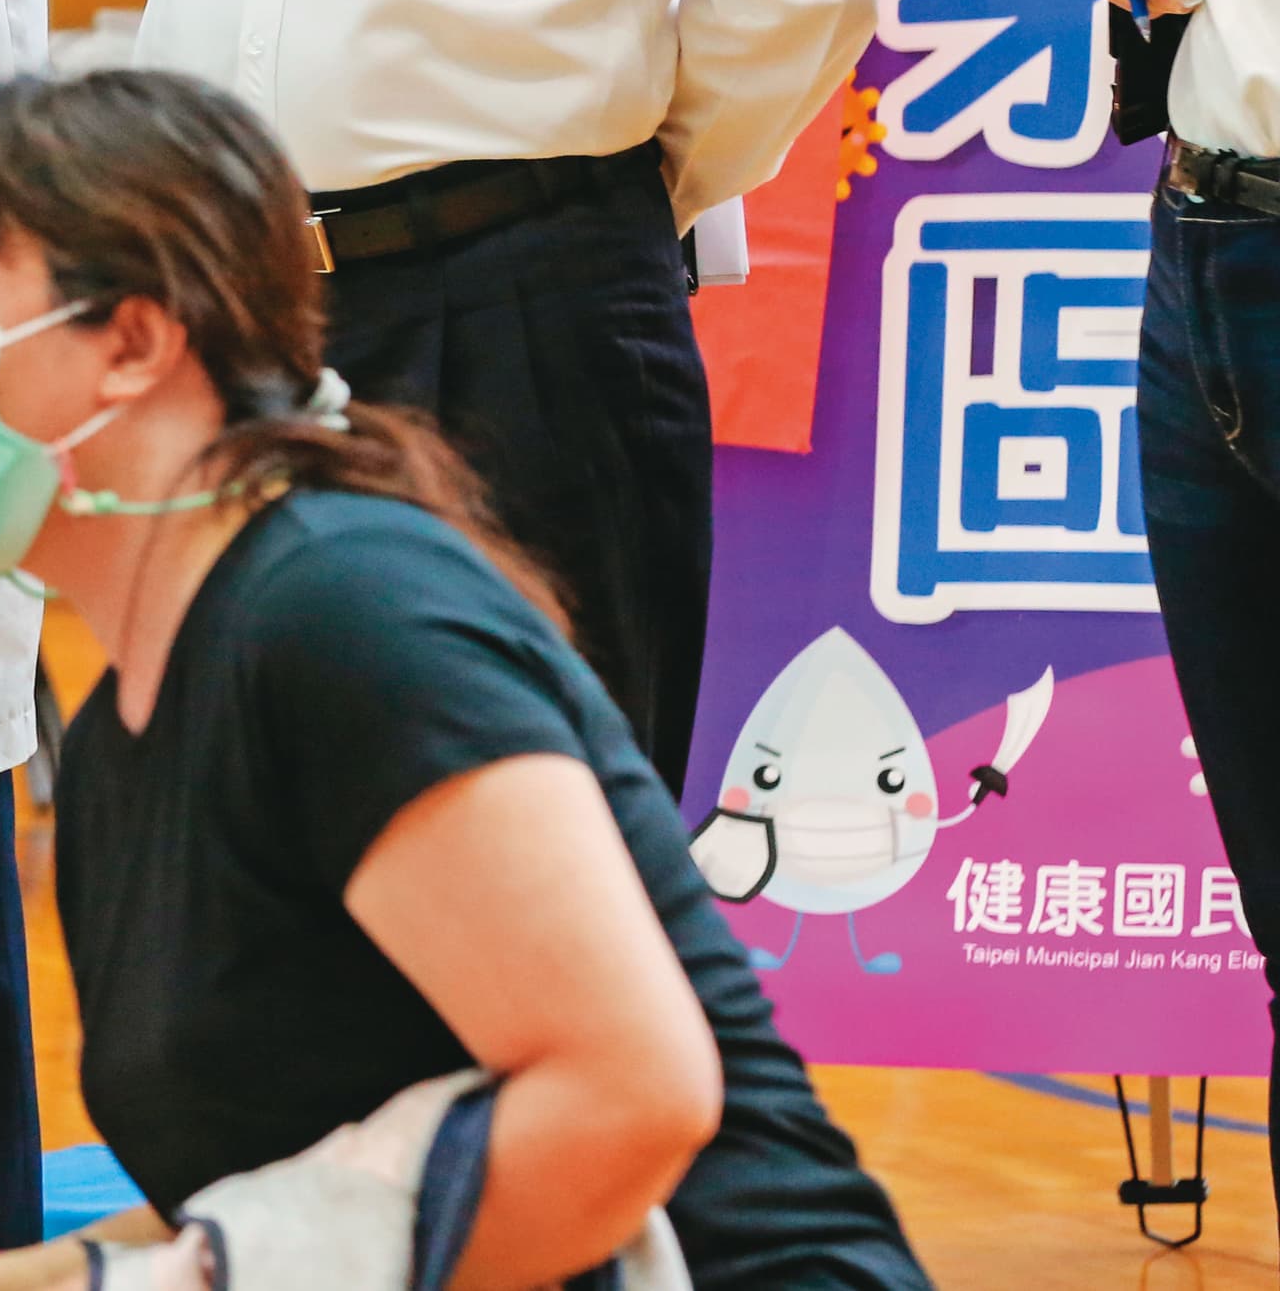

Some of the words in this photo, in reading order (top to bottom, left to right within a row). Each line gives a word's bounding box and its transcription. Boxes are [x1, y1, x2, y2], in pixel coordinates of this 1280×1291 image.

[946, 857, 1253, 937] 健康國民
[963, 942, 1020, 967] Taipei
[1027, 945, 1119, 970] Municipal
[1125, 948, 1165, 969] Jian
[1171, 949, 1221, 973] Kang
